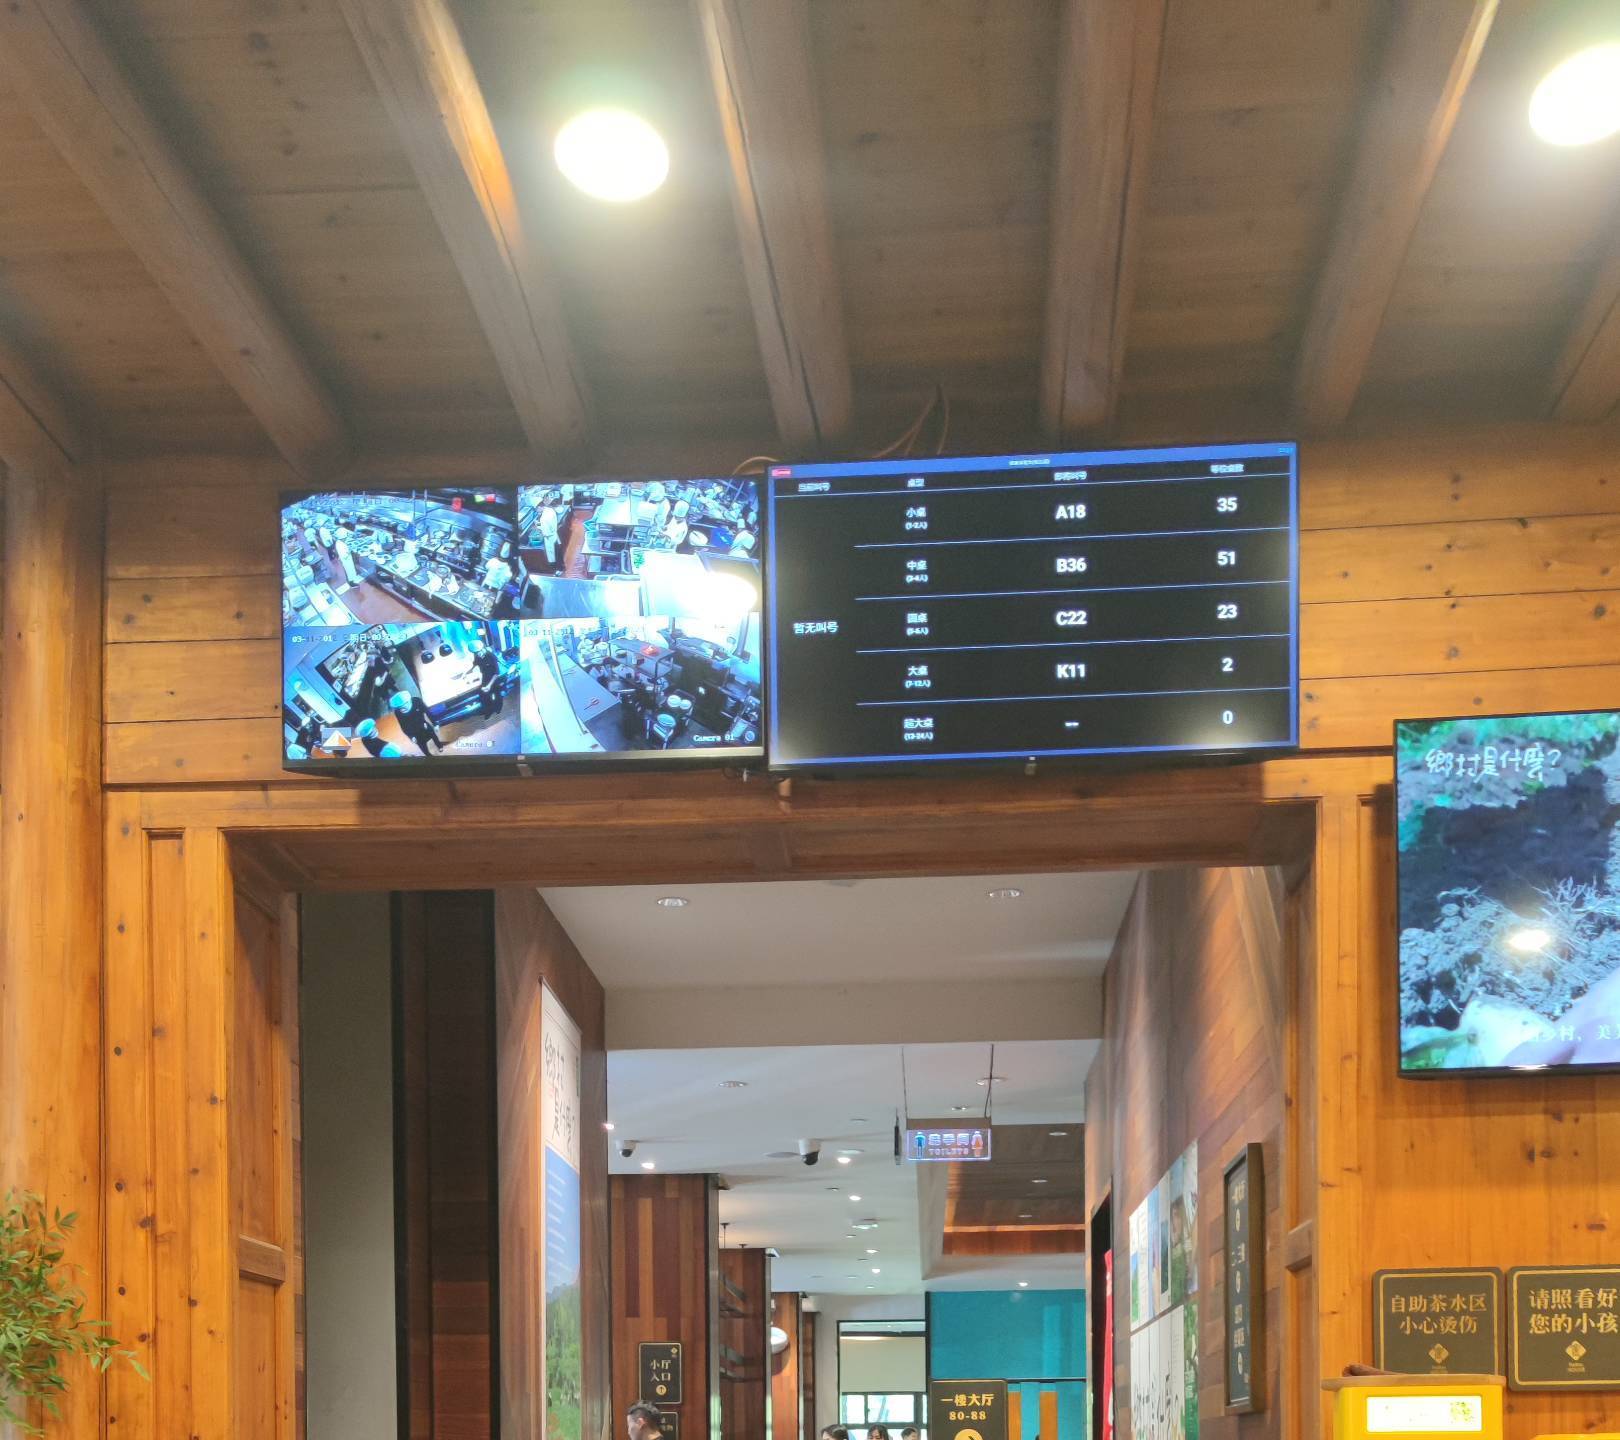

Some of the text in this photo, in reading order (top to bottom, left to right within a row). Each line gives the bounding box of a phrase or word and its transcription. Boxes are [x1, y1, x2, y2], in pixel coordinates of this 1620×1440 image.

[1055, 504, 1087, 520] A18
[1216, 497, 1238, 512] 35
[1056, 557, 1087, 573] B36
[1216, 551, 1237, 566] 51
[1056, 611, 1088, 626] C22
[1217, 604, 1238, 619] 23
[793, 621, 839, 634] 暂无叫号
[1056, 663, 1086, 679] K11
[1222, 657, 1233, 671] 2
[1222, 710, 1233, 725] 0
[1391, 1293, 1488, 1313] 自助茶水区
[1529, 1288, 1619, 1311] 请照看好
[1400, 1314, 1478, 1335] 小心烫伤
[1529, 1311, 1619, 1335] 您的小孩
[650, 1359, 672, 1370] 小厅
[650, 1372, 671, 1382] 入口
